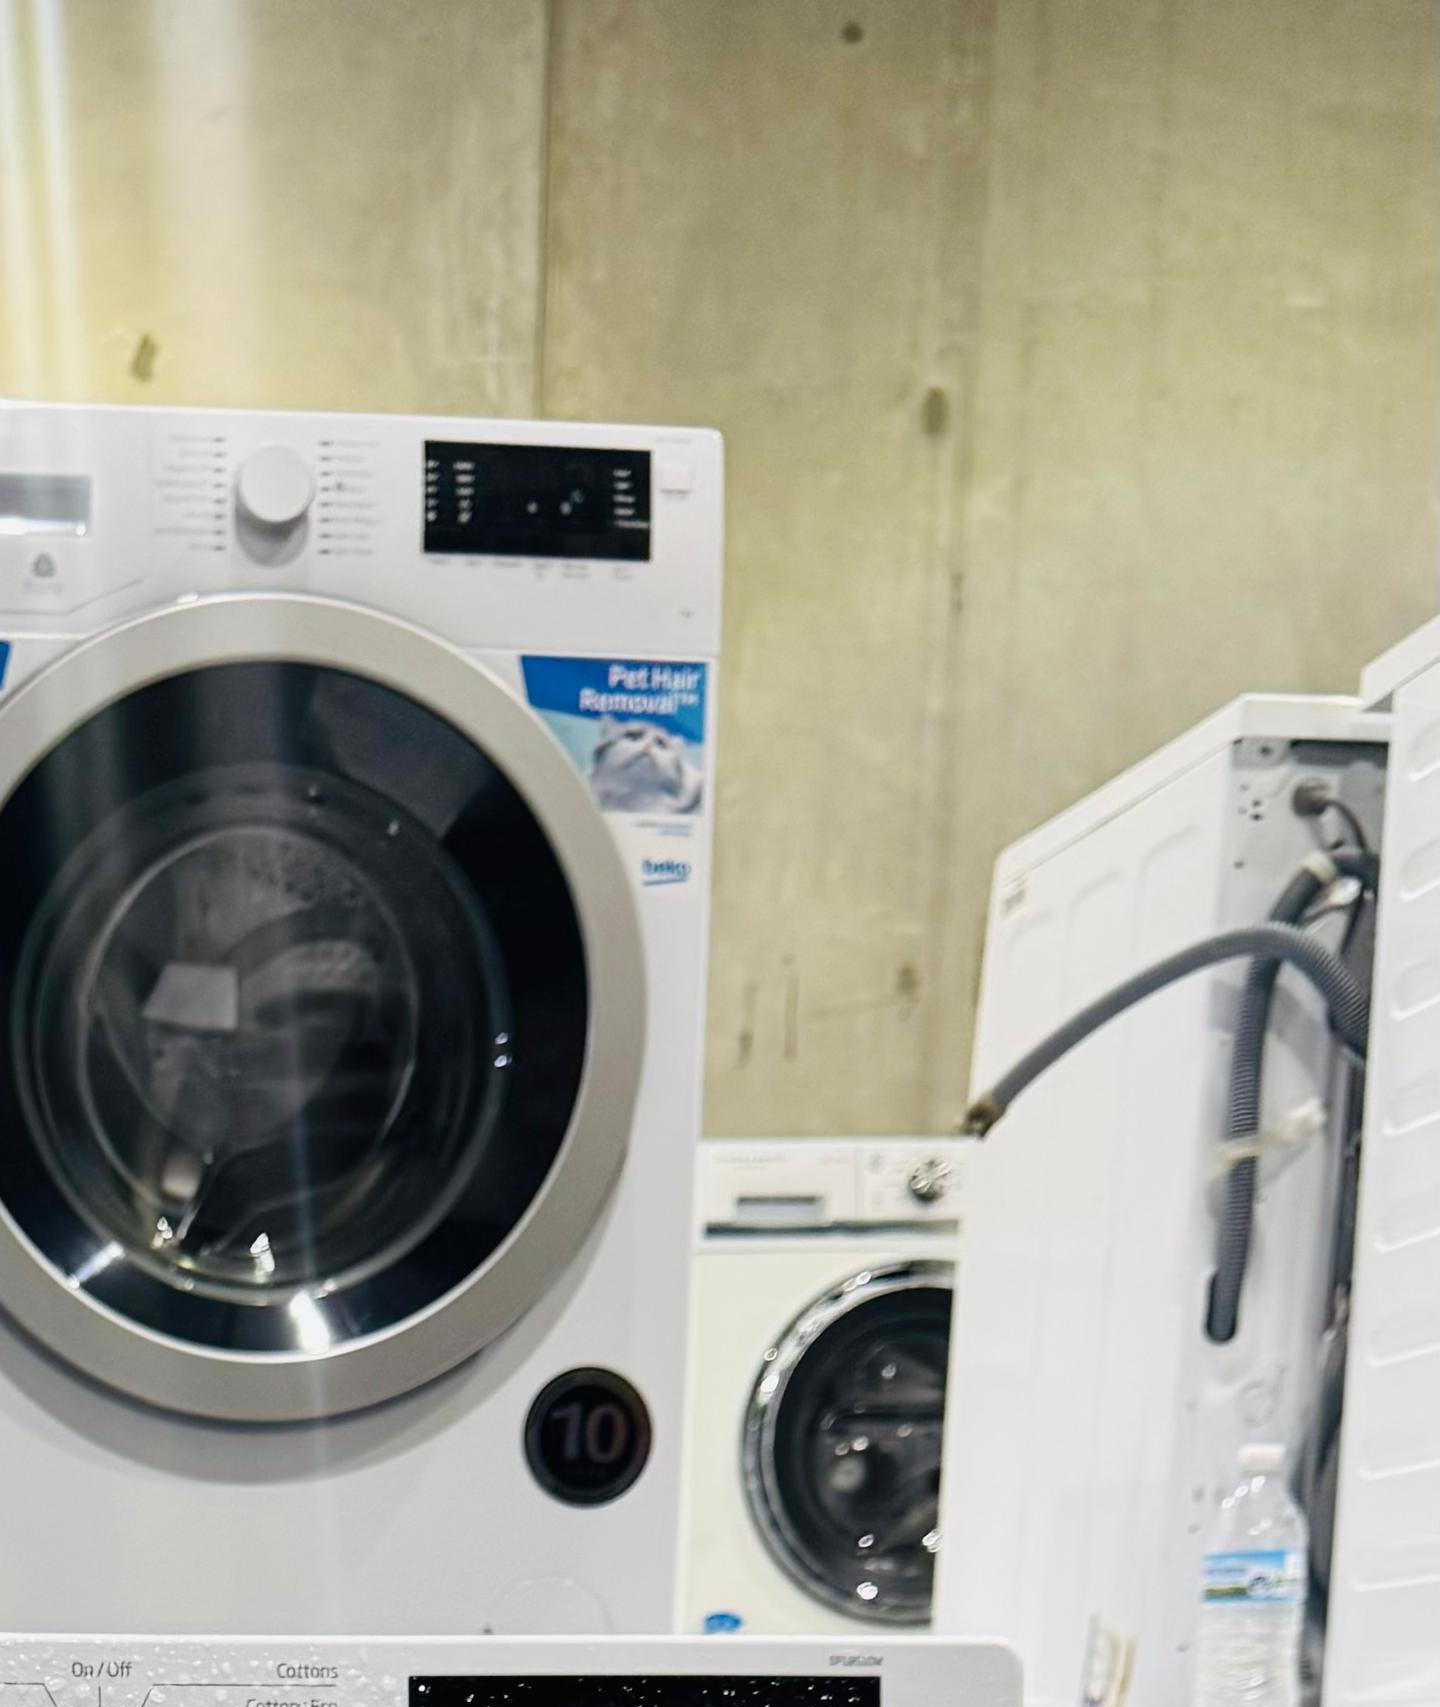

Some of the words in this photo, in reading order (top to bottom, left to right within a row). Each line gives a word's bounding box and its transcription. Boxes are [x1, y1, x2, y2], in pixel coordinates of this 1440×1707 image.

[608, 664, 648, 690] Pet
[651, 665, 698, 691] Hair
[642, 859, 691, 877] beko
[550, 1400, 628, 1464] 10
[72, 1662, 94, 1677] On
[107, 1661, 133, 1678] Off
[276, 1663, 339, 1679] Cottons
